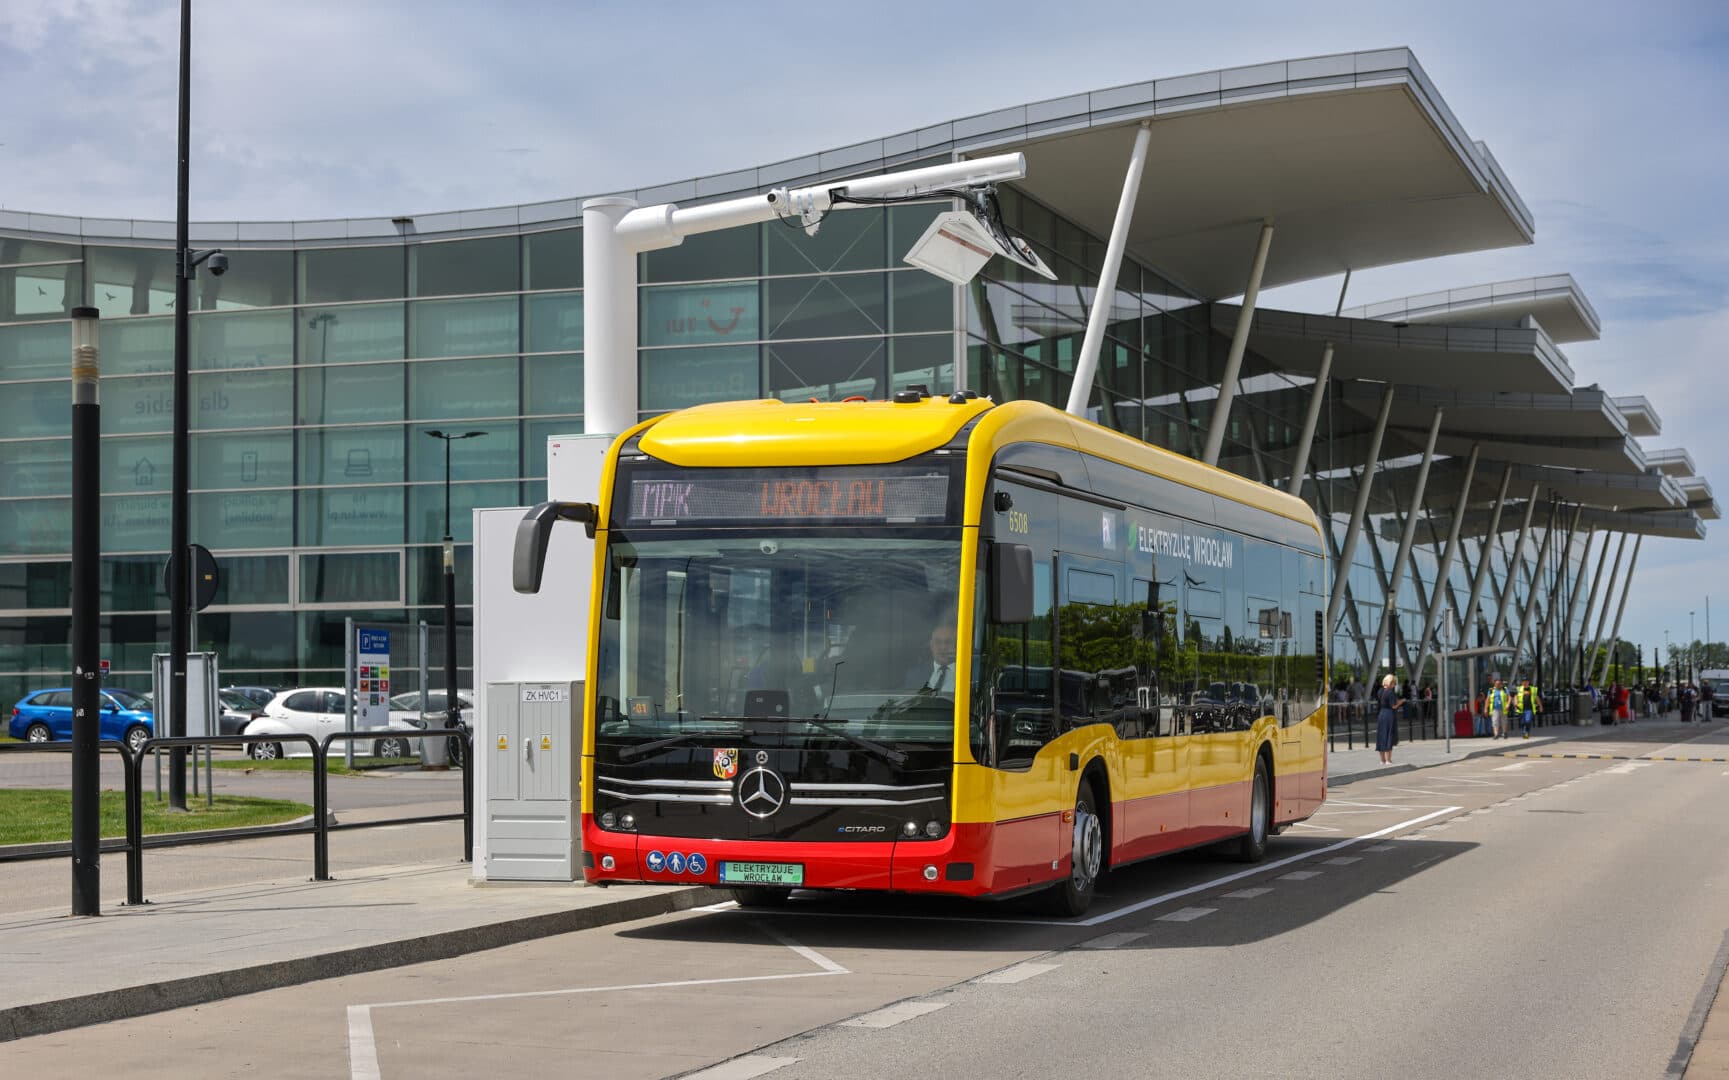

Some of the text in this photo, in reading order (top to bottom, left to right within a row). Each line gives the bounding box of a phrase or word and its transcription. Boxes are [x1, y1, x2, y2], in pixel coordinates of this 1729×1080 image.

[642, 480, 885, 517] MPK WROCŁAW
[1009, 510, 1029, 534] 6508
[1138, 526, 1233, 569] ELEKTRYZUJĘ WROCŁAW
[526, 691, 537, 701] ZK
[538, 691, 559, 701] HVC1
